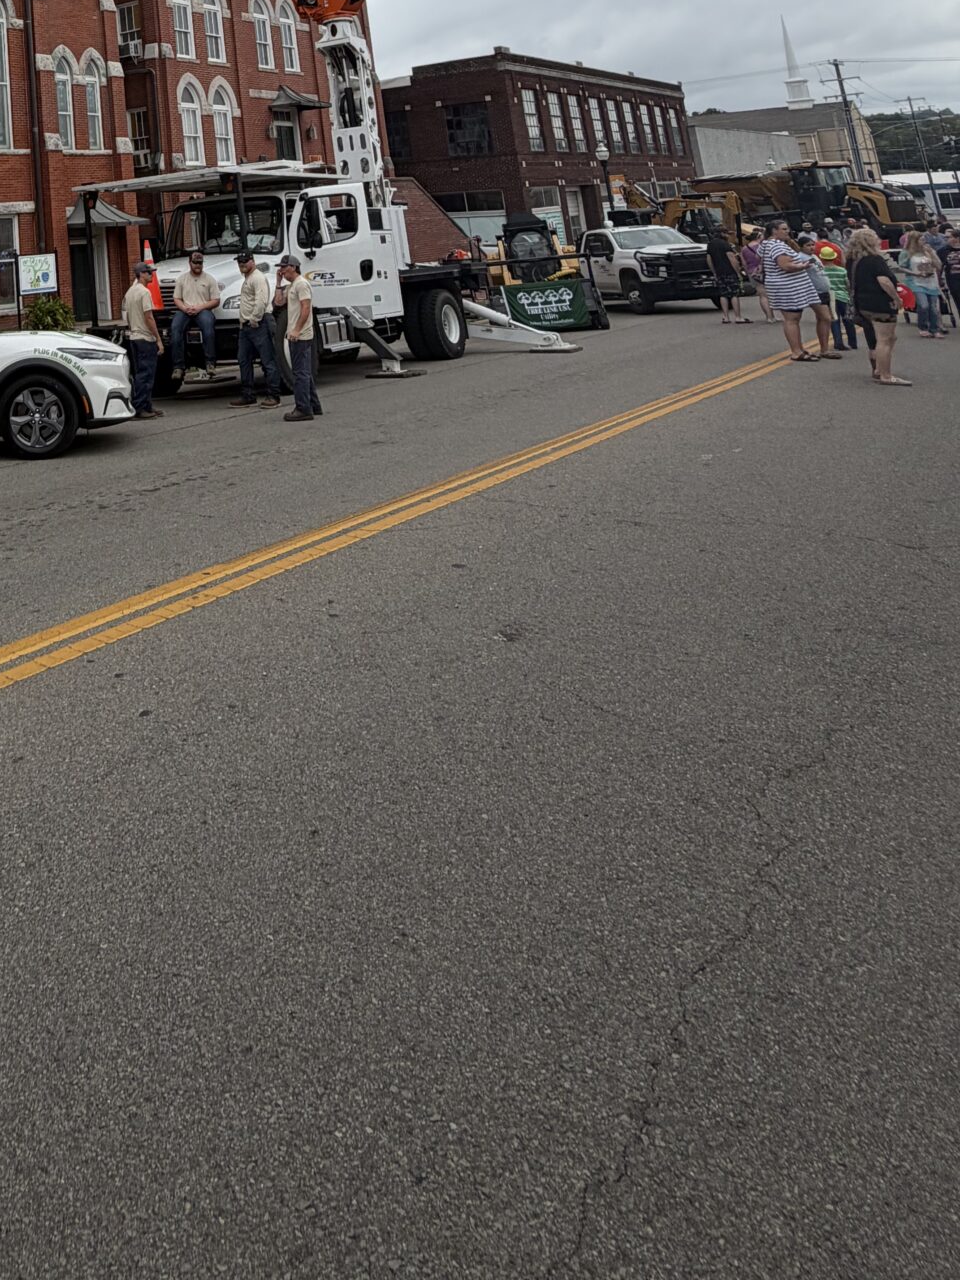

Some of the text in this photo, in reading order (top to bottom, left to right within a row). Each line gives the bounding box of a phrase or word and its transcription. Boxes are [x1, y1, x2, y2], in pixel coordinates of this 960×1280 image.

[313, 272, 336, 280] PES
[59, 354, 72, 364] AND
[72, 362, 87, 377] SAVE
